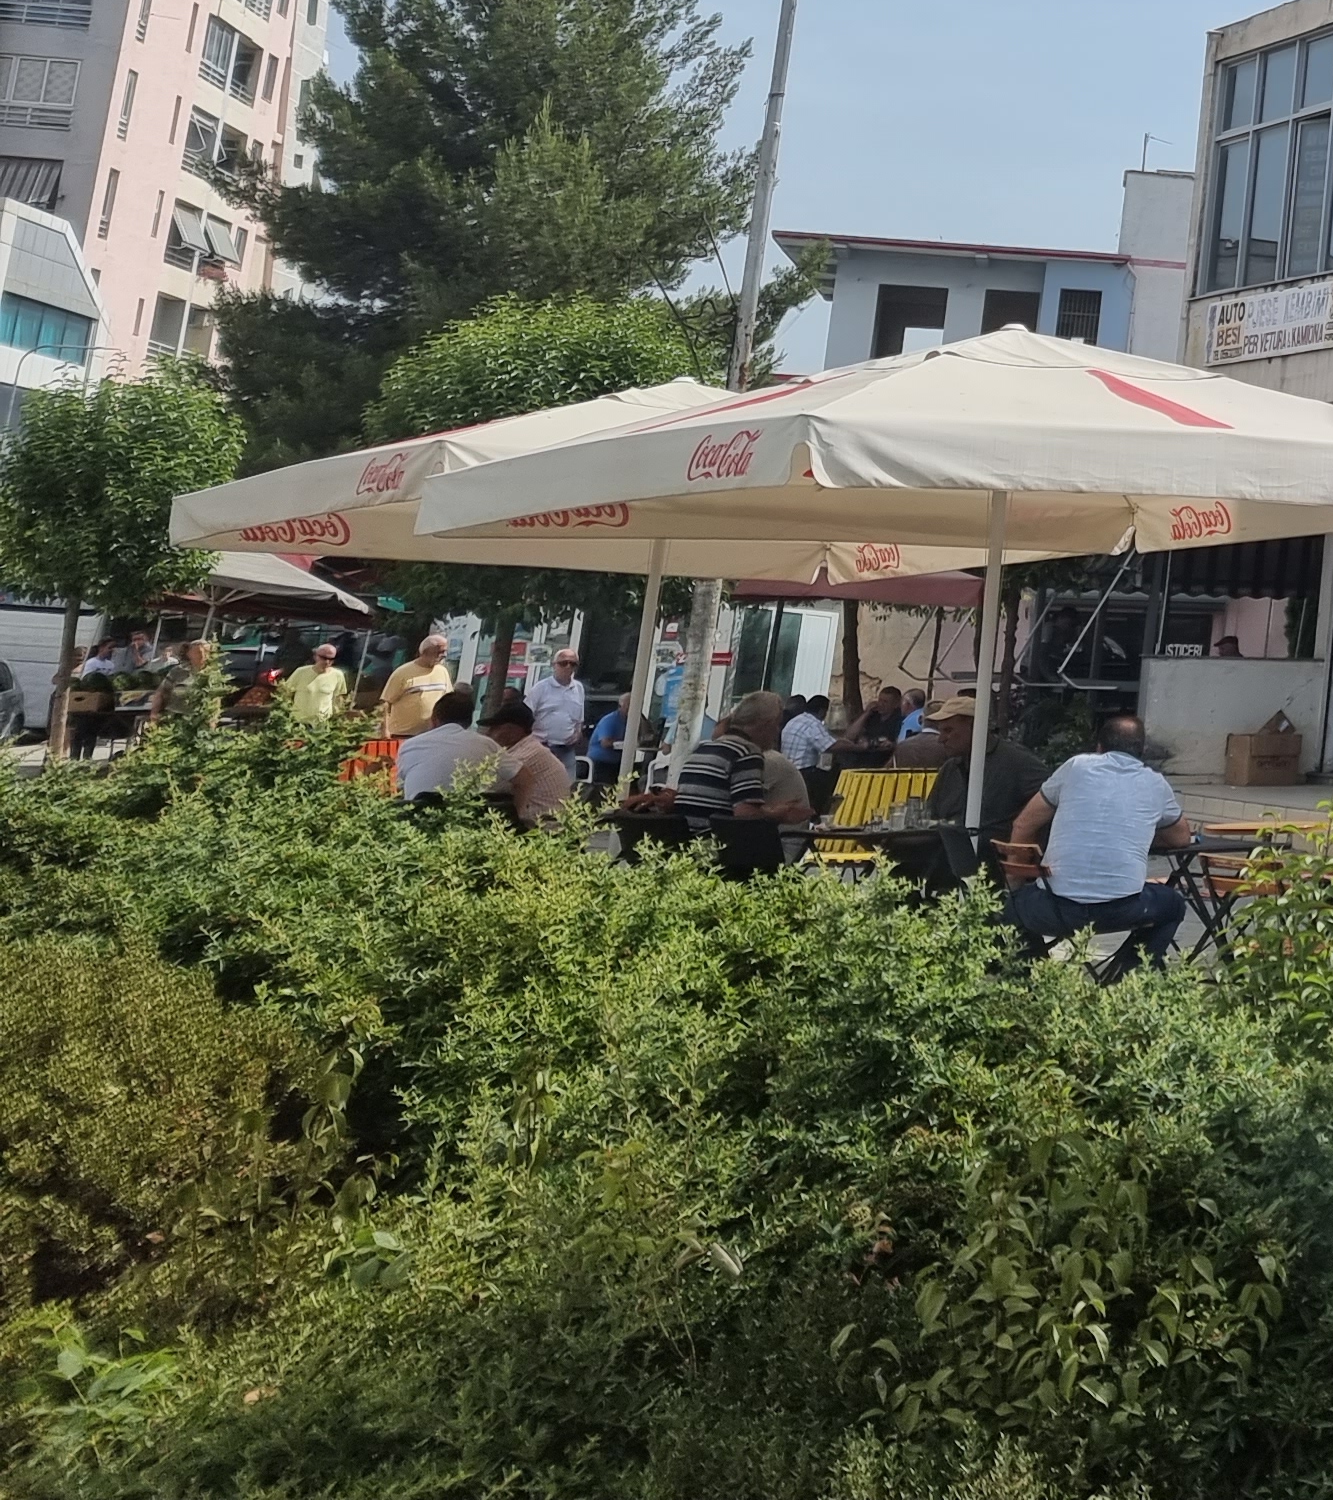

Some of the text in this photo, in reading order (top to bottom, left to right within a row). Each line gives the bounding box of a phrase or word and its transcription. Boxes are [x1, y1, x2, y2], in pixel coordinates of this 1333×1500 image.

[1217, 301, 1246, 327] AUTO
[1216, 325, 1242, 348] BESI
[1242, 334, 1260, 355] PER
[687, 428, 764, 482] Coca-Cola
[356, 453, 409, 495] Coca-Cola
[1164, 643, 1203, 657] STICERI
